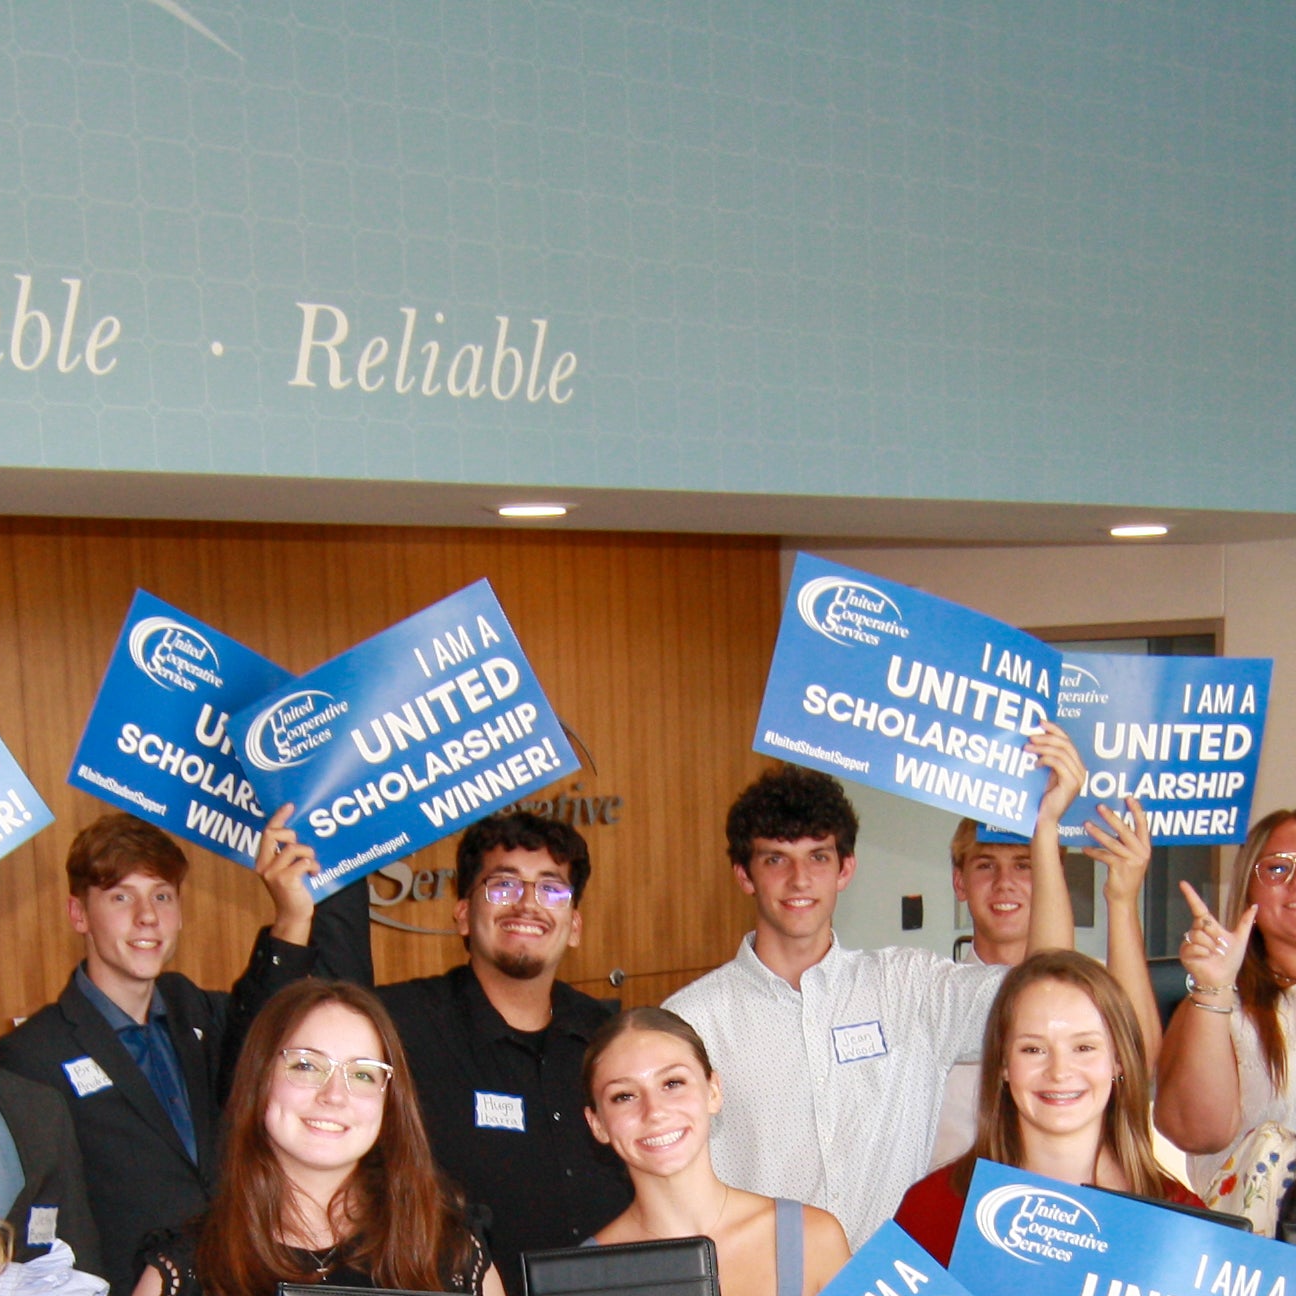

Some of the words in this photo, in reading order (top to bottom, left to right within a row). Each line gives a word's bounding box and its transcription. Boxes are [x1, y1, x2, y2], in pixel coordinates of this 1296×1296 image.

[287, 301, 579, 404] Reliable
[834, 586, 885, 612] United
[822, 615, 880, 646] Services
[828, 602, 909, 639] Cooperative
[163, 628, 206, 661] United
[413, 647, 432, 677] I
[434, 625, 476, 672] AM
[475, 614, 500, 648] A
[147, 657, 196, 692] Services
[155, 645, 223, 689] Cooperative
[981, 643, 991, 672] I
[997, 649, 1033, 687] AM
[1035, 668, 1050, 698] A
[269, 696, 315, 732] United
[351, 657, 521, 764] UNITED
[886, 654, 1047, 736] UNITED
[1057, 690, 1108, 704] perative
[1183, 686, 1191, 714] I
[1198, 686, 1234, 714] AM
[1241, 685, 1255, 713] A
[274, 699, 349, 750] Cooperative
[803, 685, 1040, 779] SCHOLARSHIP
[1094, 723, 1252, 761] UNITED
[279, 727, 332, 765] Services
[764, 729, 870, 774] #UnitedStudentSupport
[117, 722, 265, 817] SCHOLAR
[309, 703, 539, 838] SCHOLARSHIP
[419, 737, 561, 829] WINNER!
[894, 754, 1028, 821] WINNER!
[185, 800, 262, 860] WINN
[310, 831, 411, 890] #UnitedStudentSupport
[1021, 1195, 1080, 1225] United
[1004, 1228, 1072, 1263] Services
[1012, 1211, 1108, 1252] Cooperative
[894, 1259, 929, 1295] A
[1194, 1254, 1208, 1289] I
